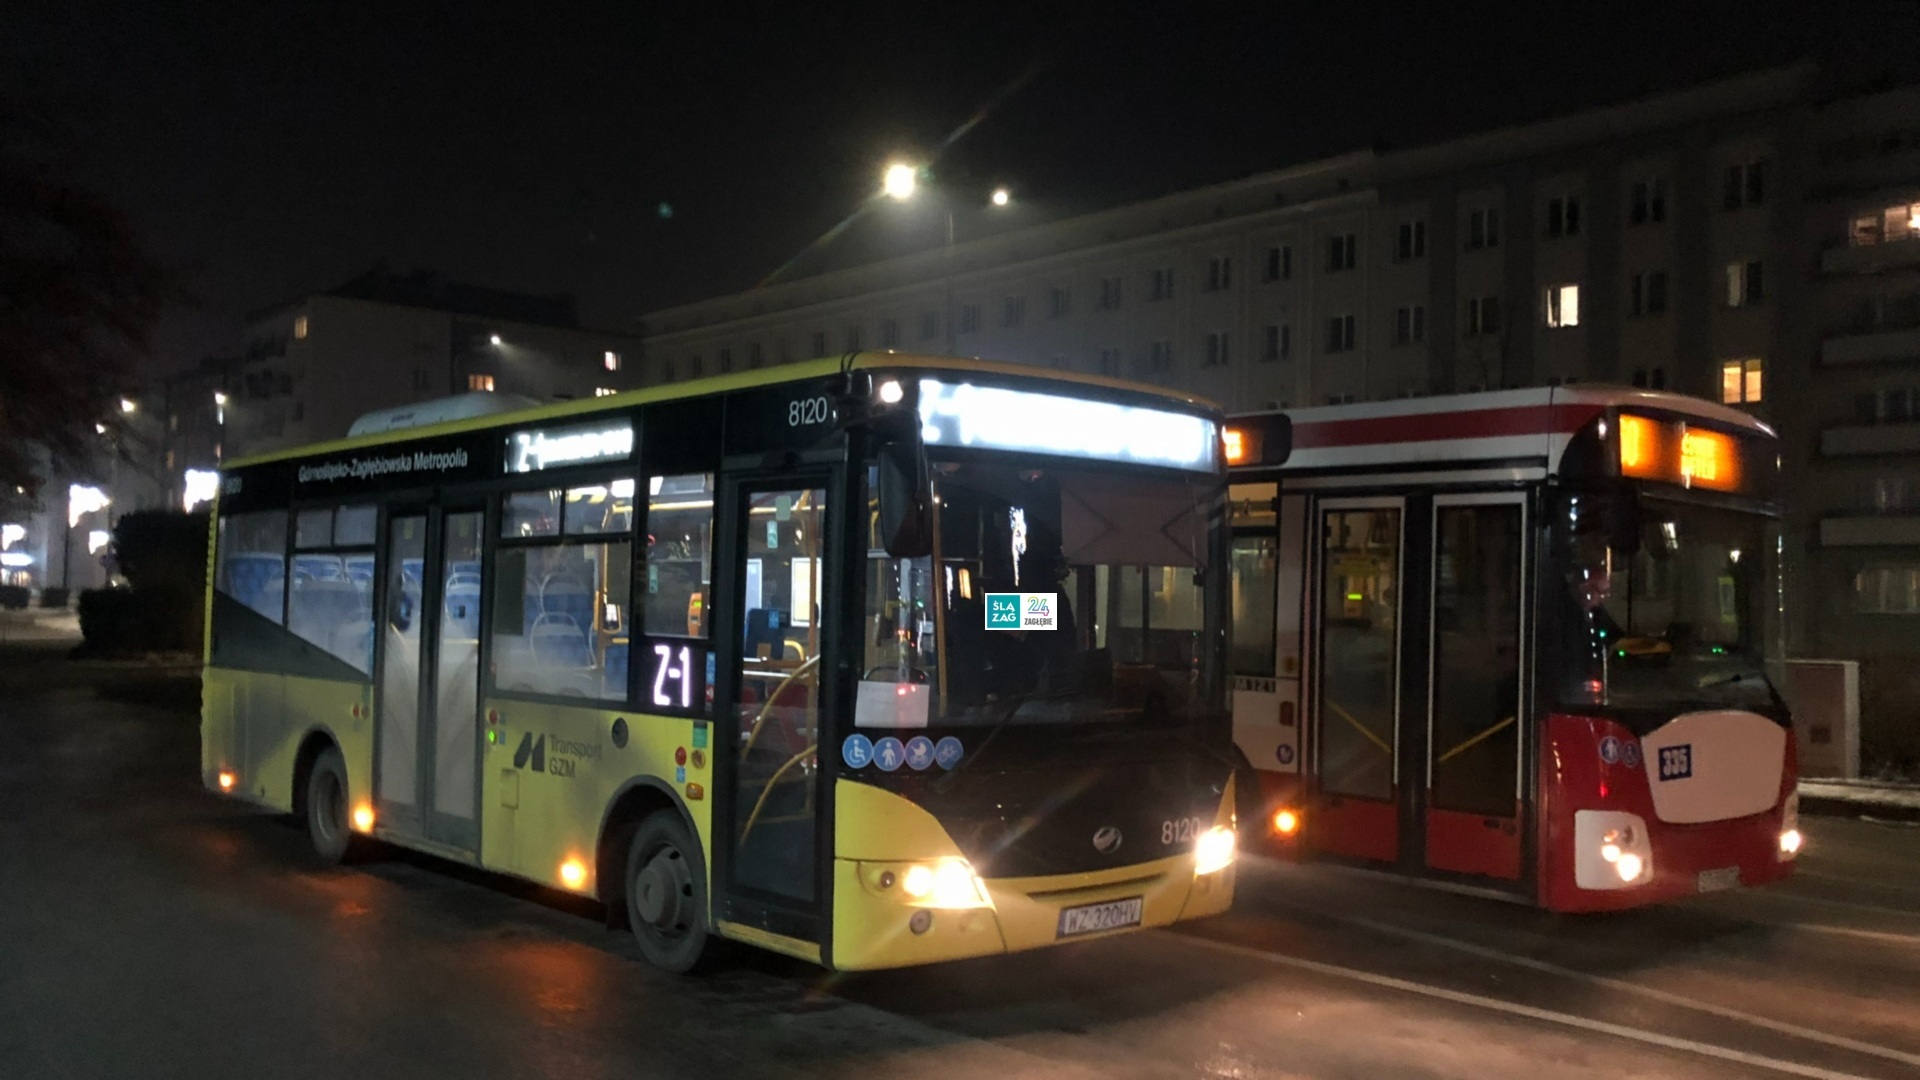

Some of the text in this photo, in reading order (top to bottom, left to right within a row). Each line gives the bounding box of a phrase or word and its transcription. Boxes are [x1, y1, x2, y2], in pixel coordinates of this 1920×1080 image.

[789, 396, 828, 427] 8120
[413, 447, 468, 472] Metropolia
[653, 645, 691, 708] Z-1
[549, 733, 603, 760] Transport
[549, 756, 576, 779] GZM
[1662, 748, 1688, 776] 335
[1161, 816, 1200, 845] 8120
[1068, 908, 1089, 932] WZ
